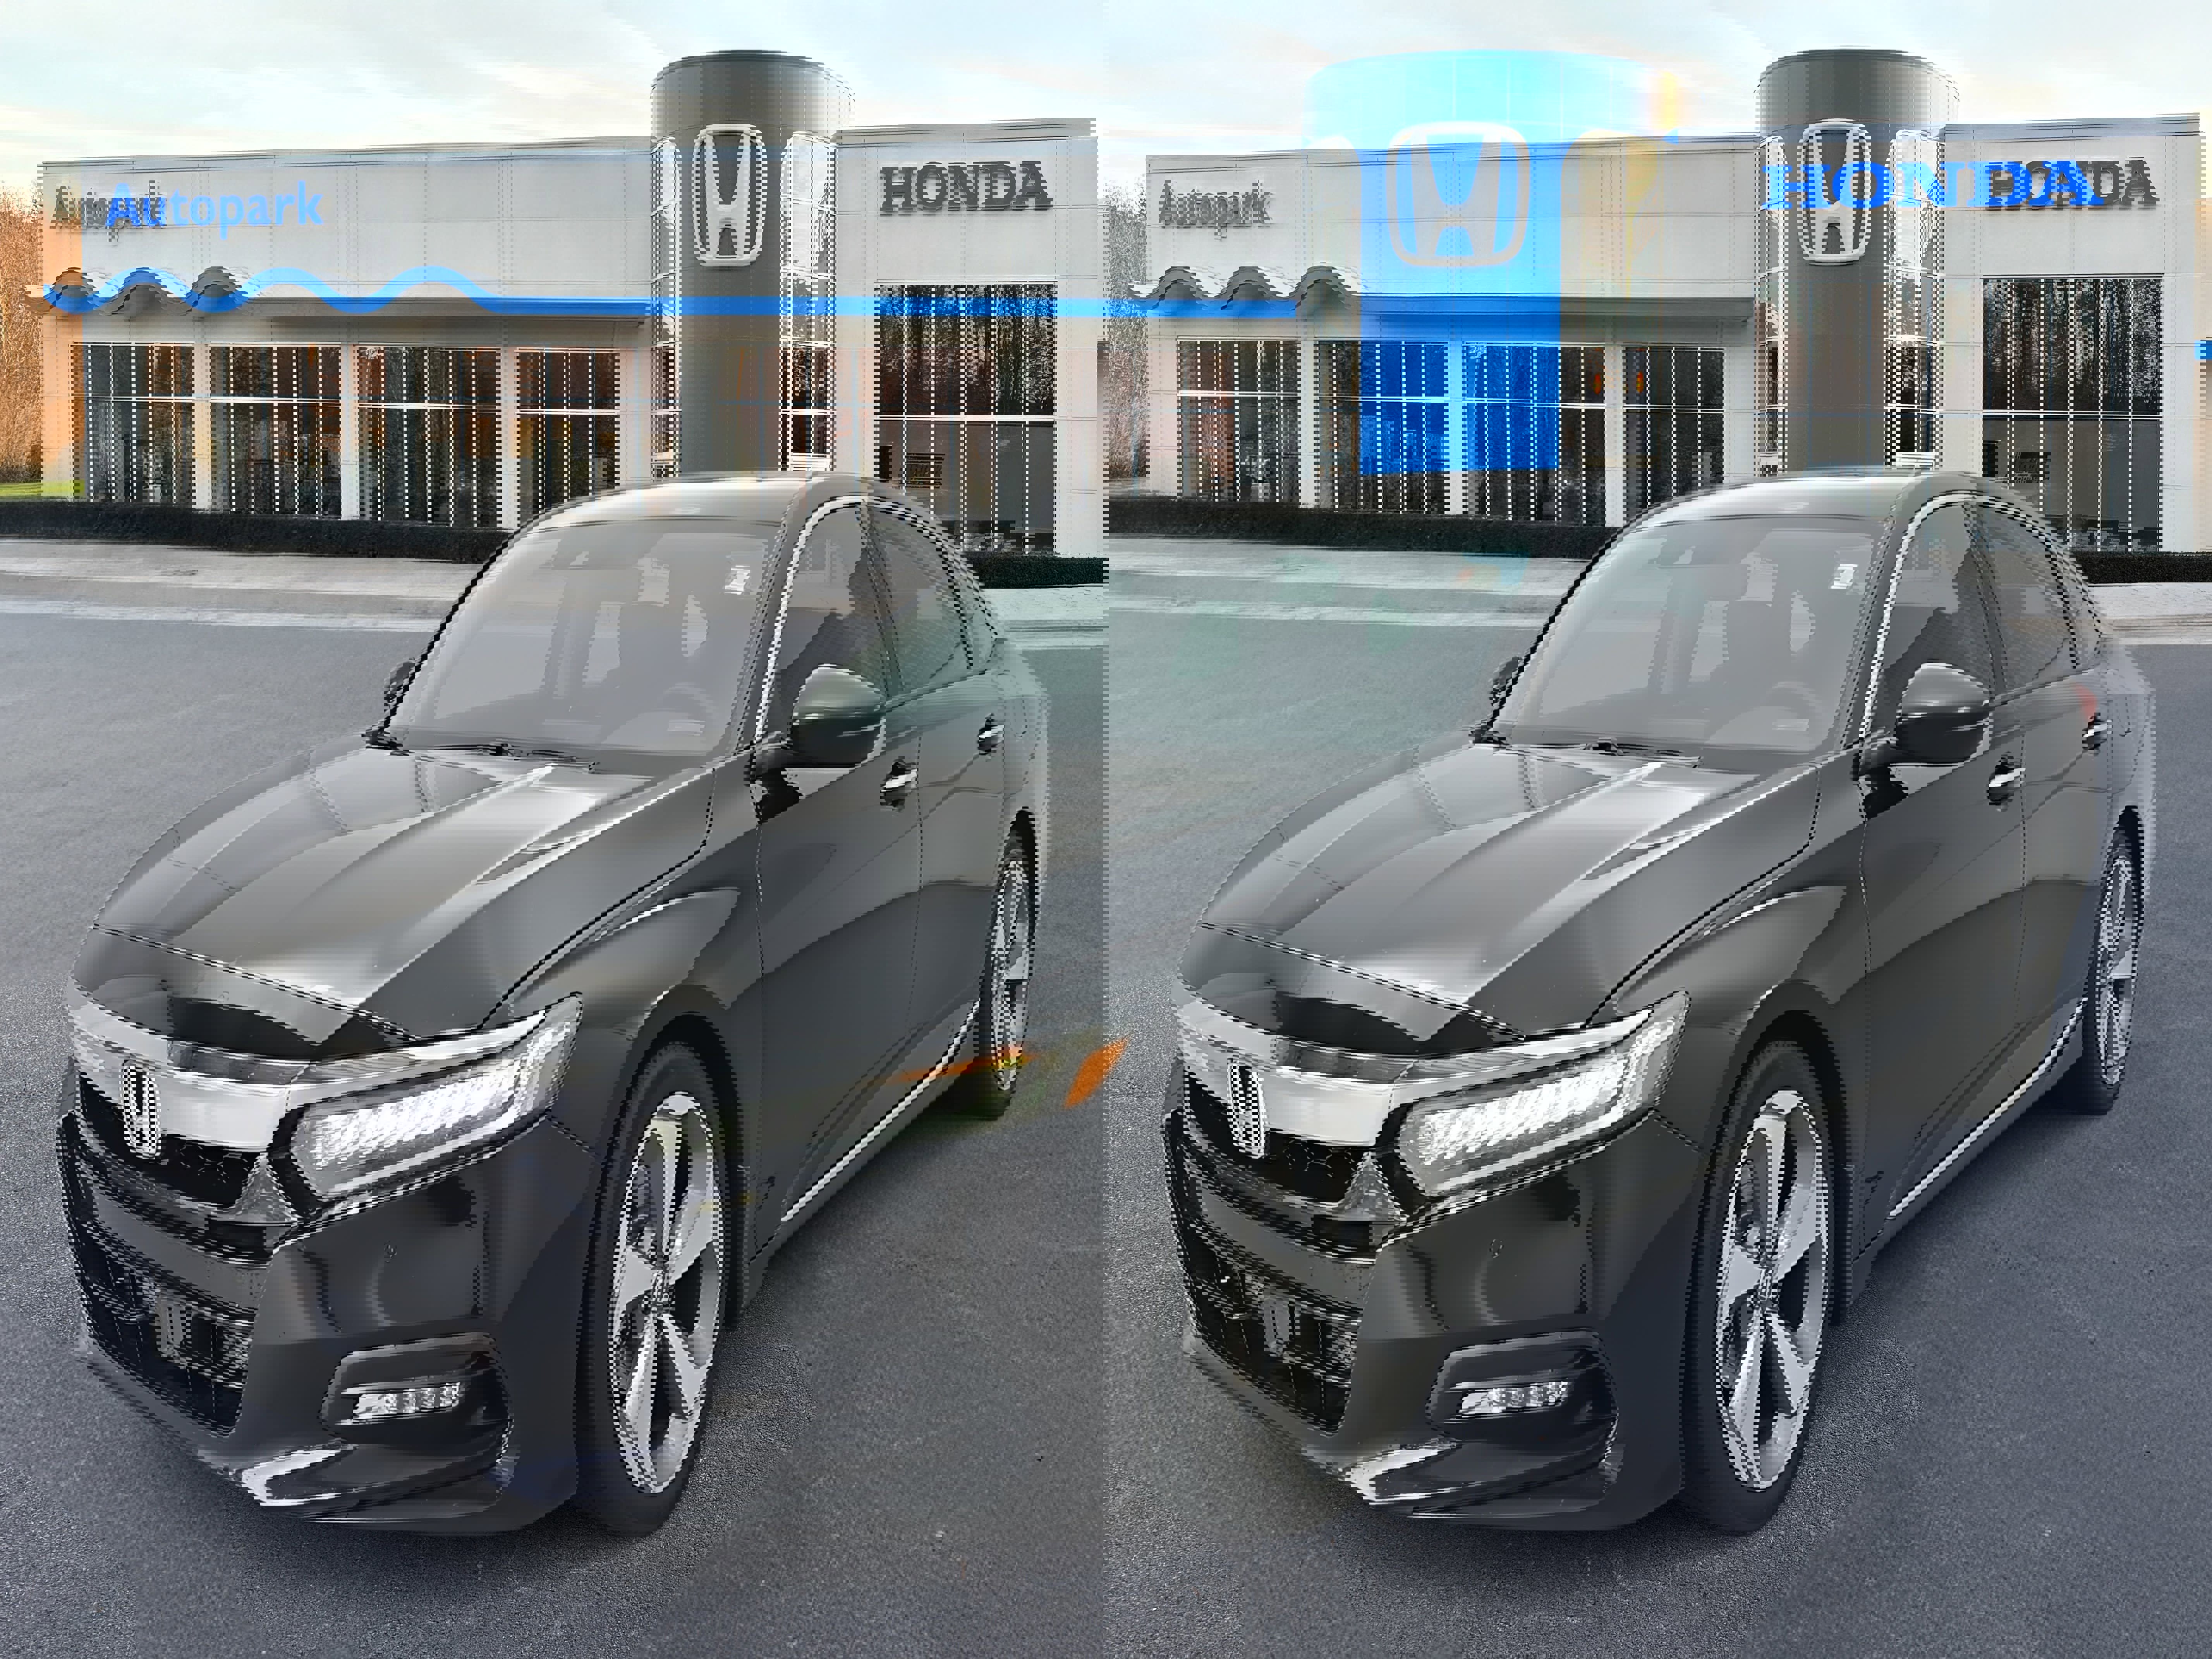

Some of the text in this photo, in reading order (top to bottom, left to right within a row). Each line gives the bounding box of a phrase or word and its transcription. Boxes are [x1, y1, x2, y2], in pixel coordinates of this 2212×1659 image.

[105, 180, 323, 240] Autopark
[879, 160, 1053, 211] HONDA
[1761, 160, 2105, 209] HONDA
